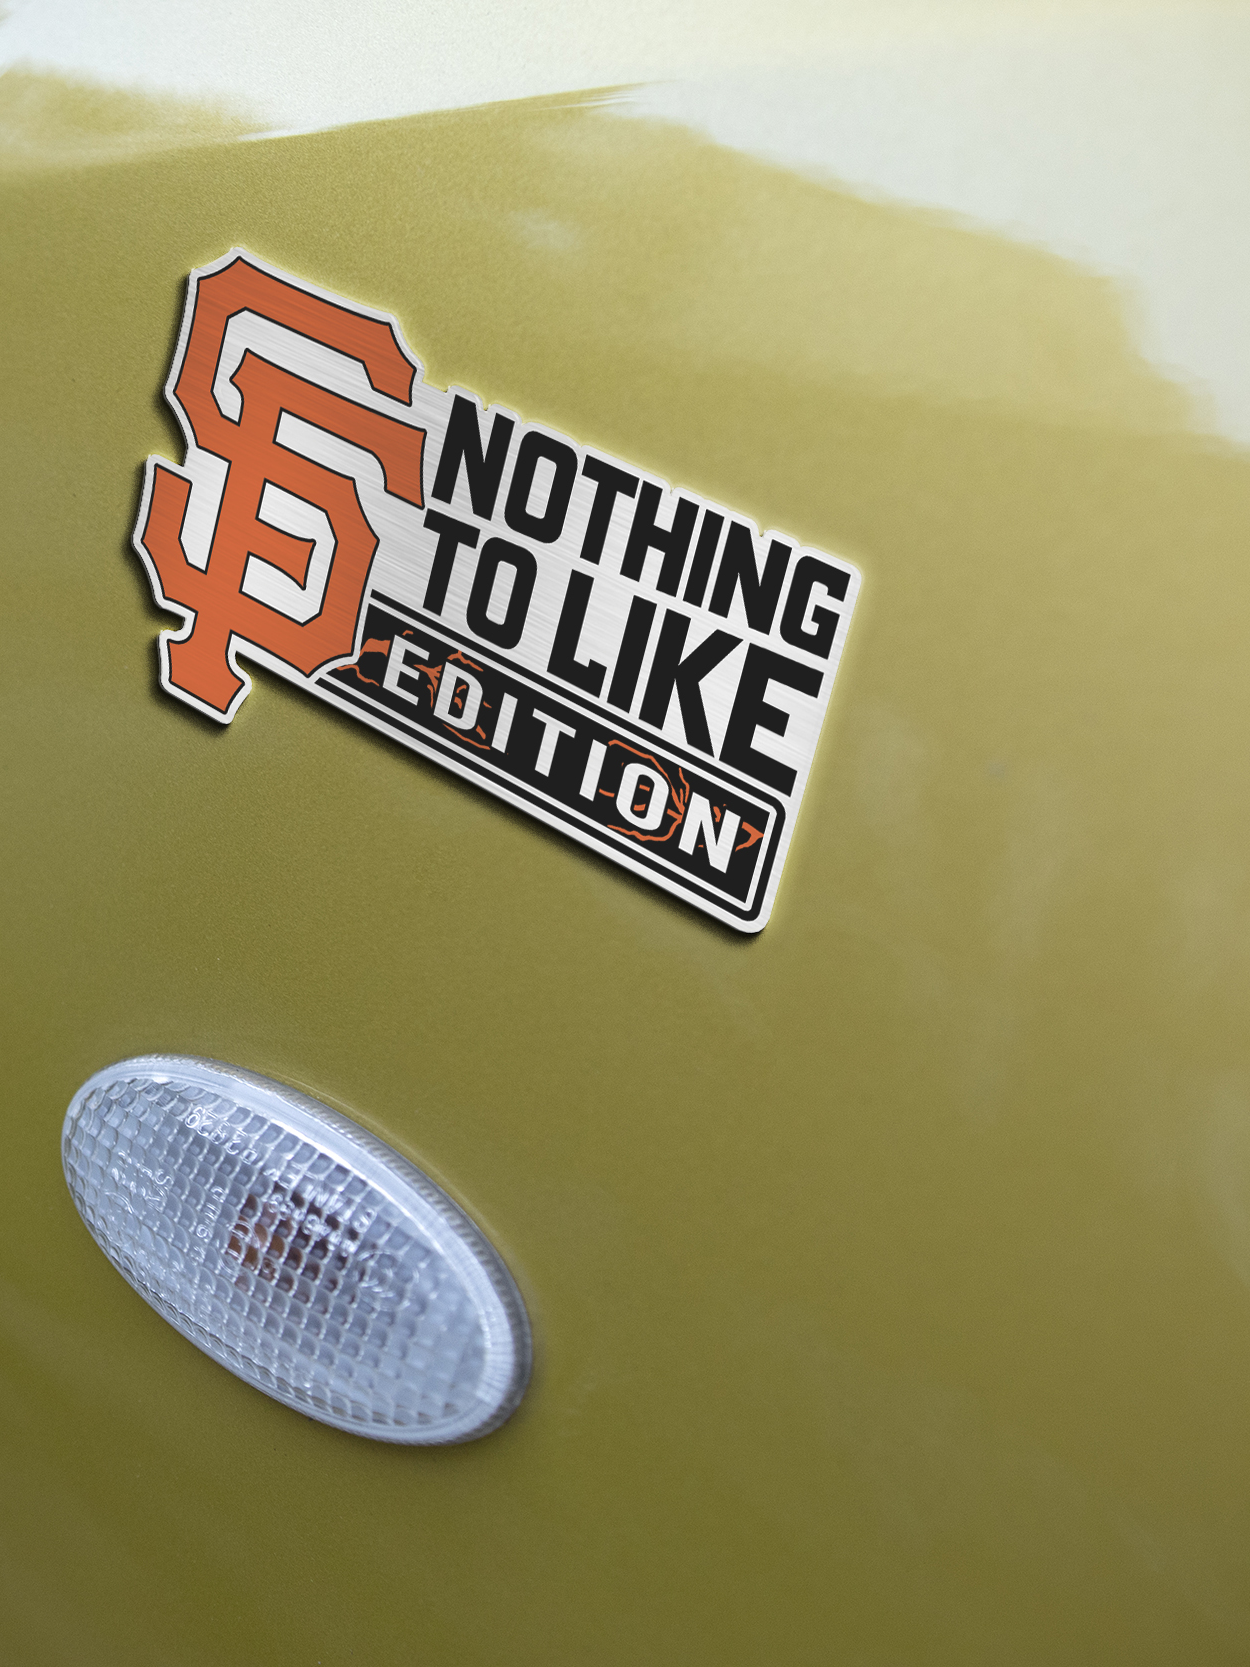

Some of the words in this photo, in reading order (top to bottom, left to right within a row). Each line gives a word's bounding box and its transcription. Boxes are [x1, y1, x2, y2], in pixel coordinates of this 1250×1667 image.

[422, 508, 538, 649] TO
[547, 569, 824, 796] LIKE
[431, 394, 851, 660] NOTHING
[382, 626, 740, 873] EDITION
